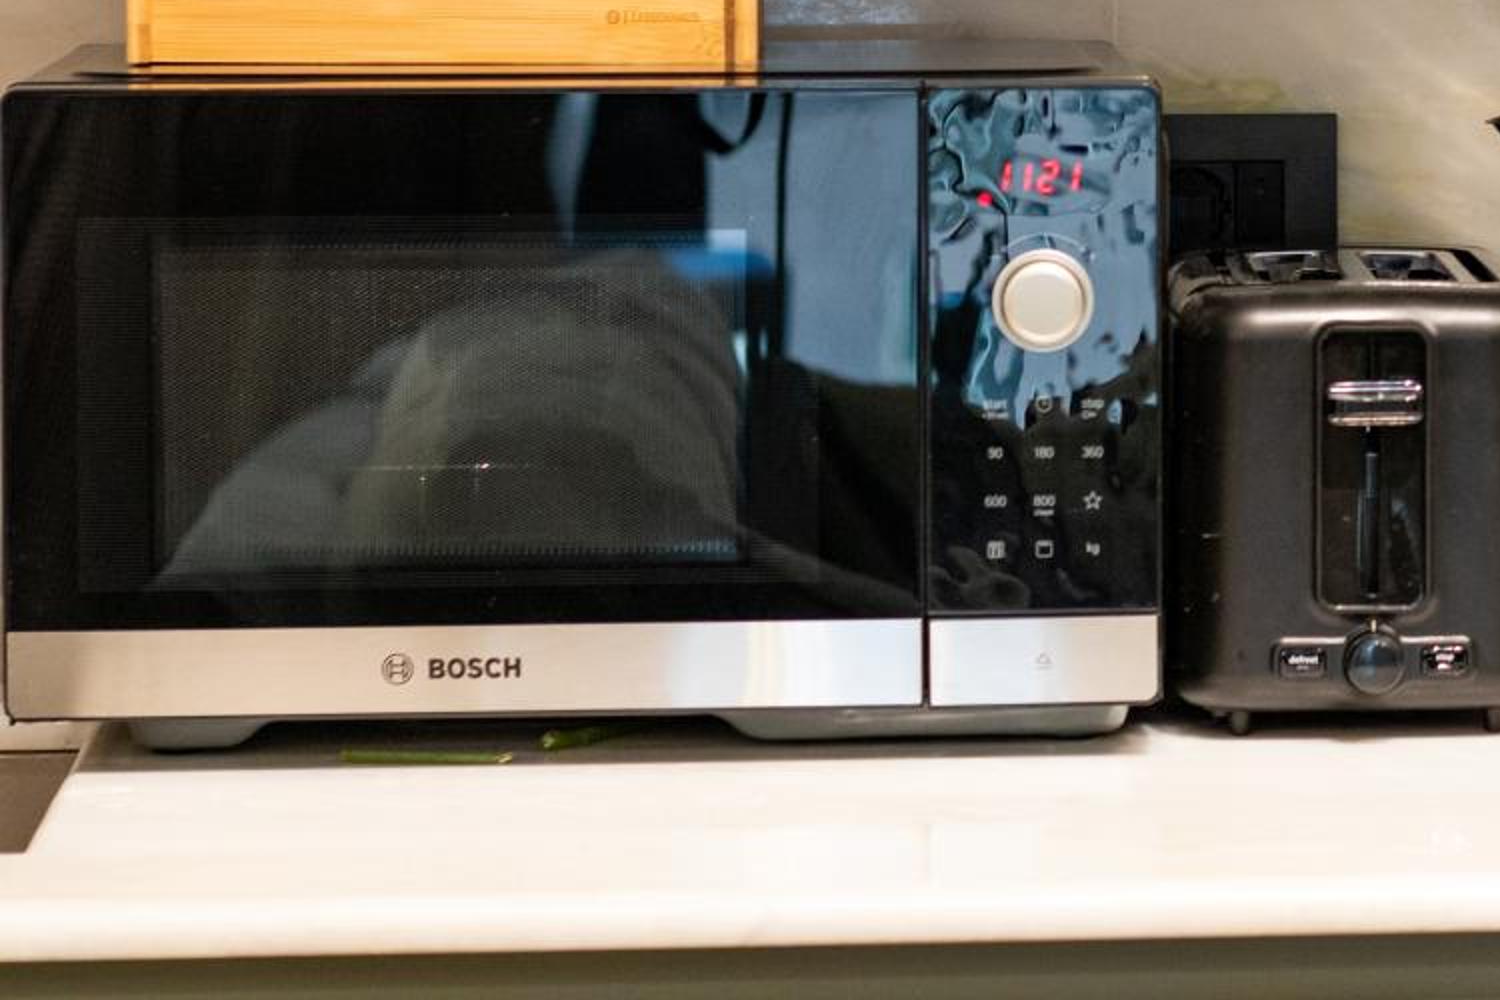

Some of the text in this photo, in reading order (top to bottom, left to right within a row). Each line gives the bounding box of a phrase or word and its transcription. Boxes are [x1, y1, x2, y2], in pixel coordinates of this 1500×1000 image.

[1034, 446, 1055, 459] 180
[1081, 446, 1105, 459] 360
[428, 657, 521, 679] BOSCH
